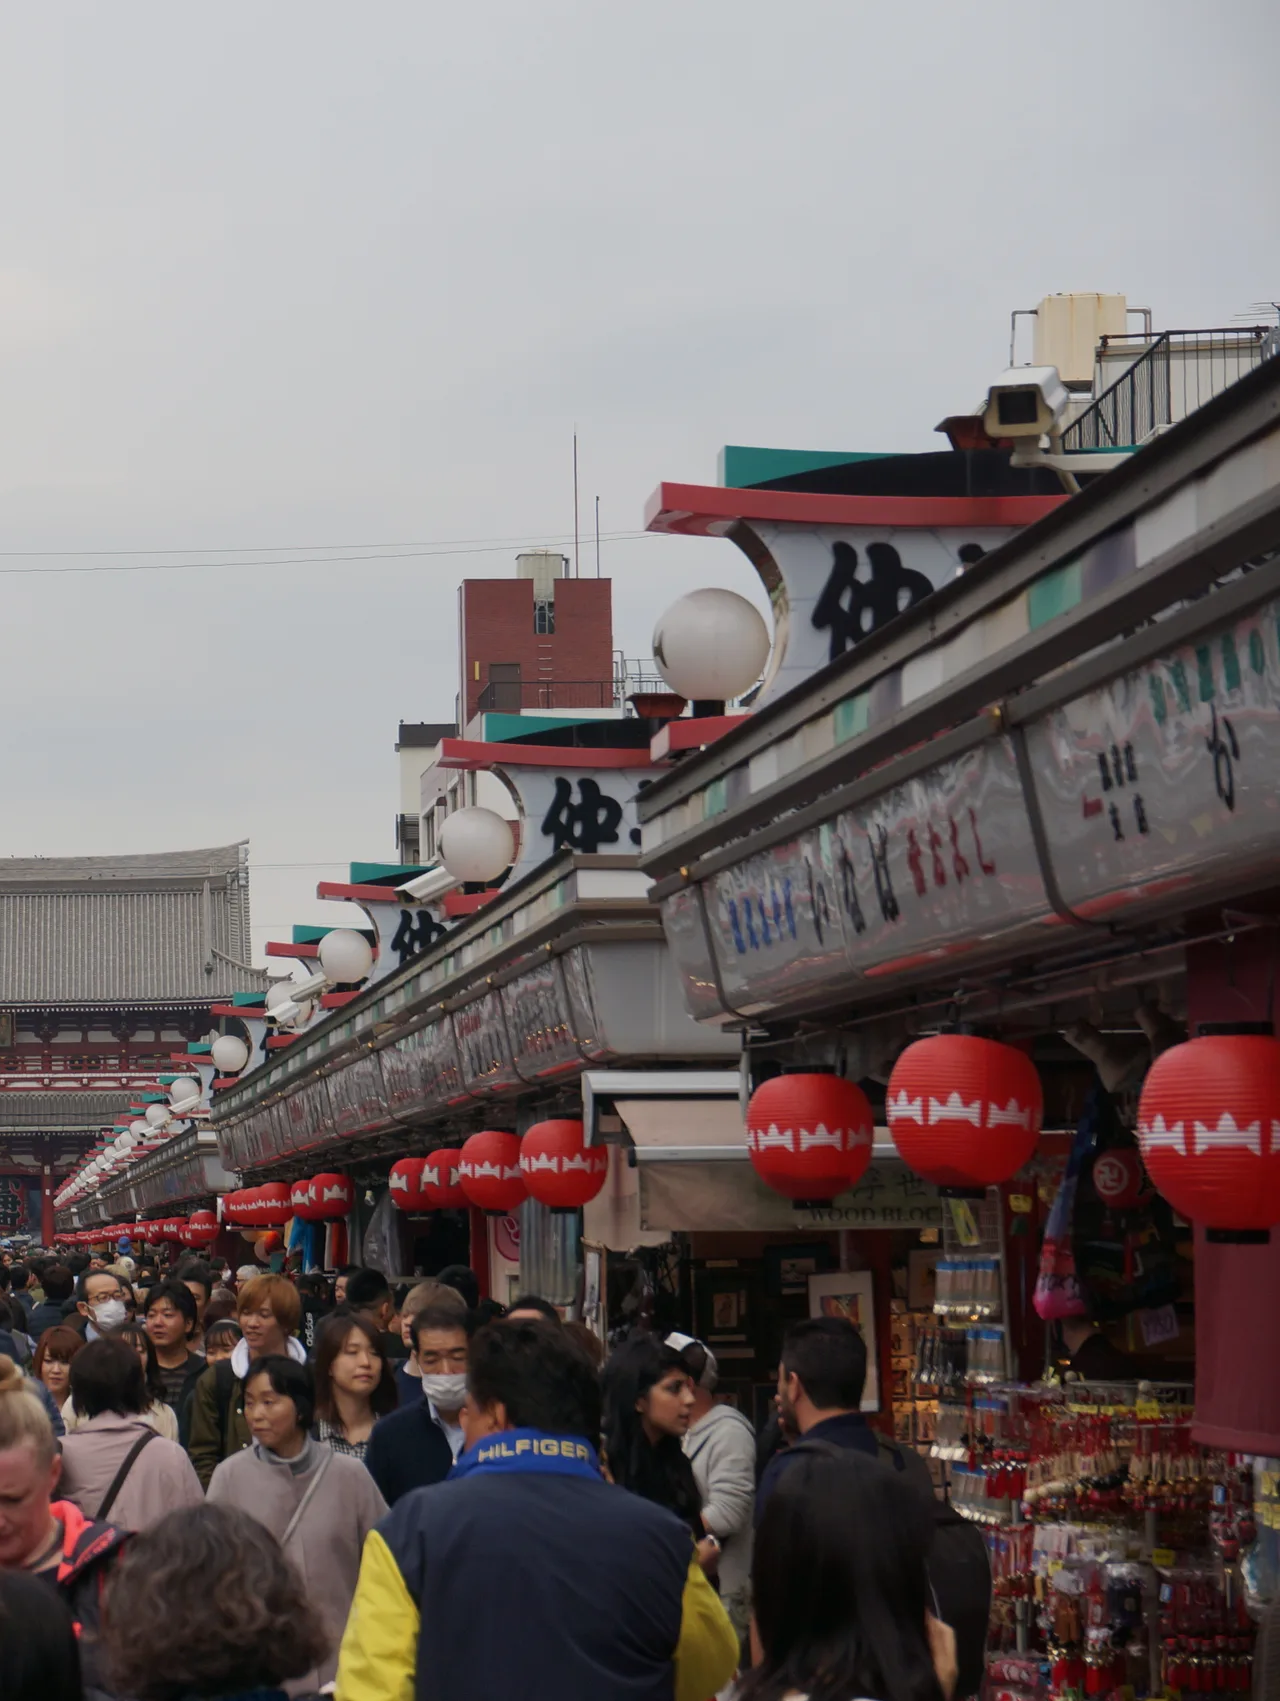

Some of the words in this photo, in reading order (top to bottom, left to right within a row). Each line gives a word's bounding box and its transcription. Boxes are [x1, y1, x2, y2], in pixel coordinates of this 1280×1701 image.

[812, 540, 988, 661] 仲
[541, 777, 645, 854] 仲
[809, 1206, 876, 1222] WOOD
[878, 1206, 942, 1221] BLOC
[304, 1311, 313, 1347] adidas
[477, 1438, 590, 1462] HILFIGER
